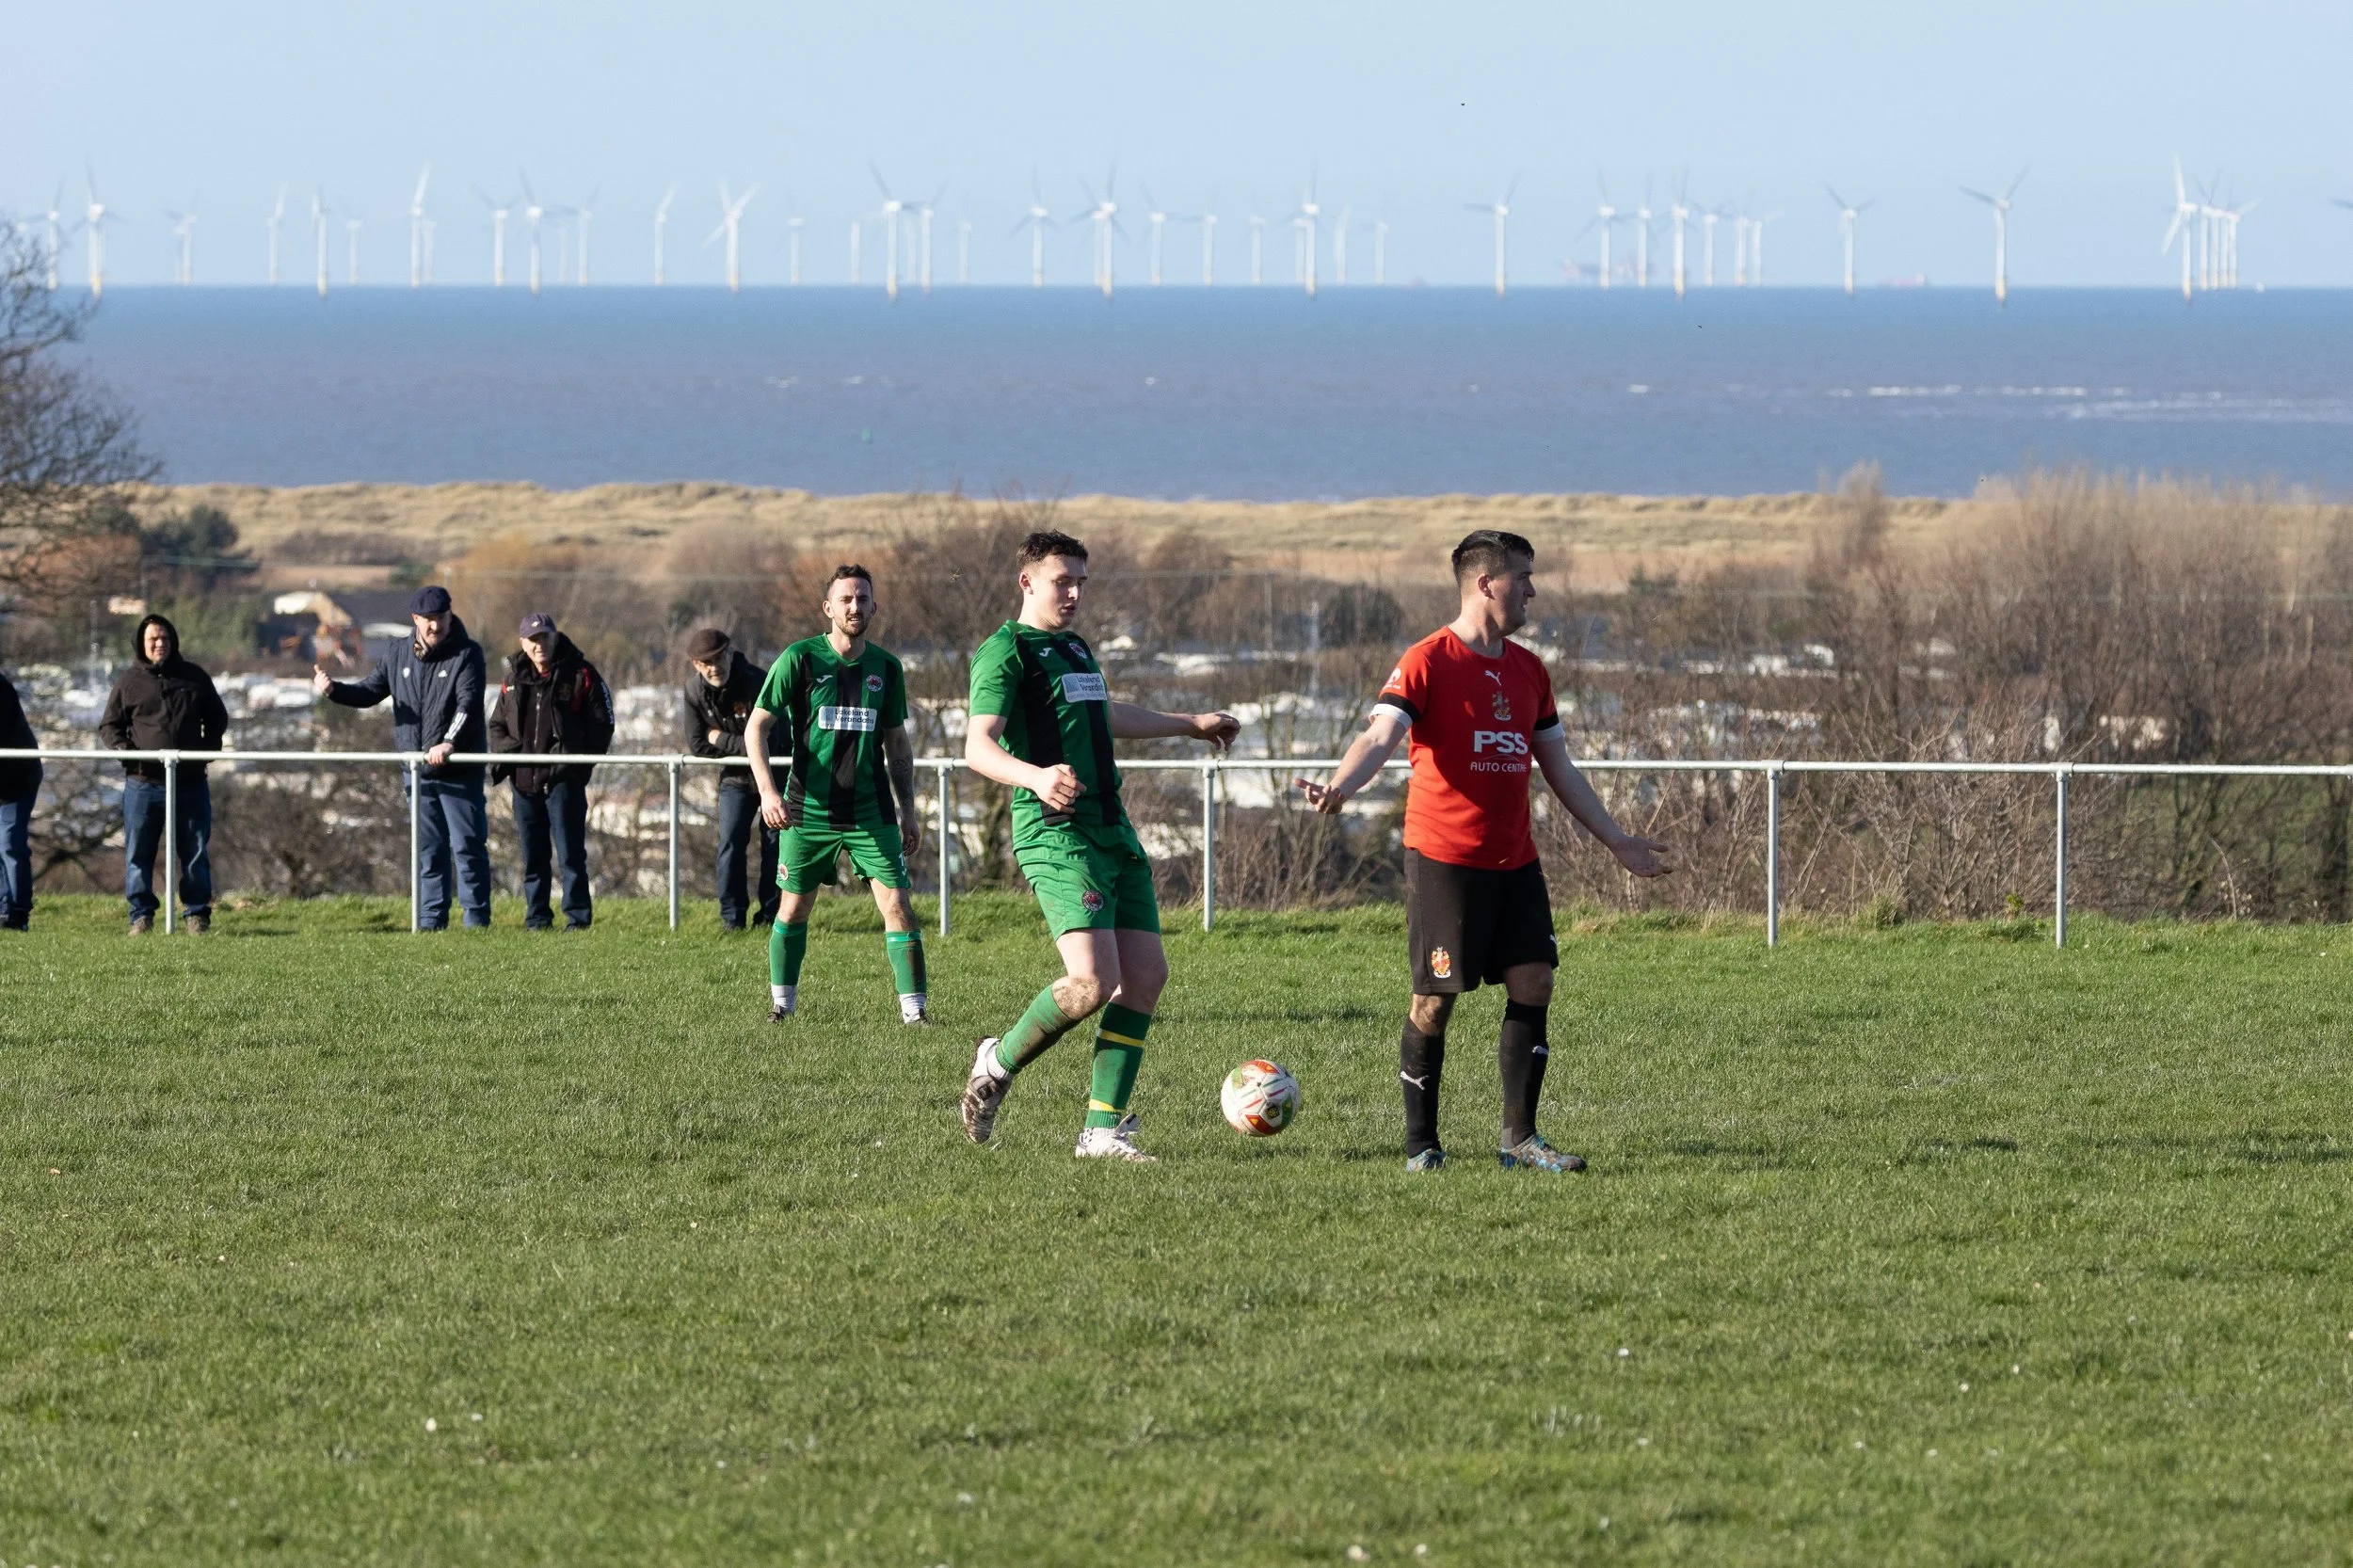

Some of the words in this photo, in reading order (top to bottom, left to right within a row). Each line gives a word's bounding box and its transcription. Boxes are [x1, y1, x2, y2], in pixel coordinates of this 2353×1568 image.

[835, 709, 870, 717] Lakeland
[835, 716, 874, 725] Verandahs
[1474, 730, 1529, 755] PSS
[1470, 761, 1500, 772] AUTO
[1501, 762, 1527, 773] CENTRE
